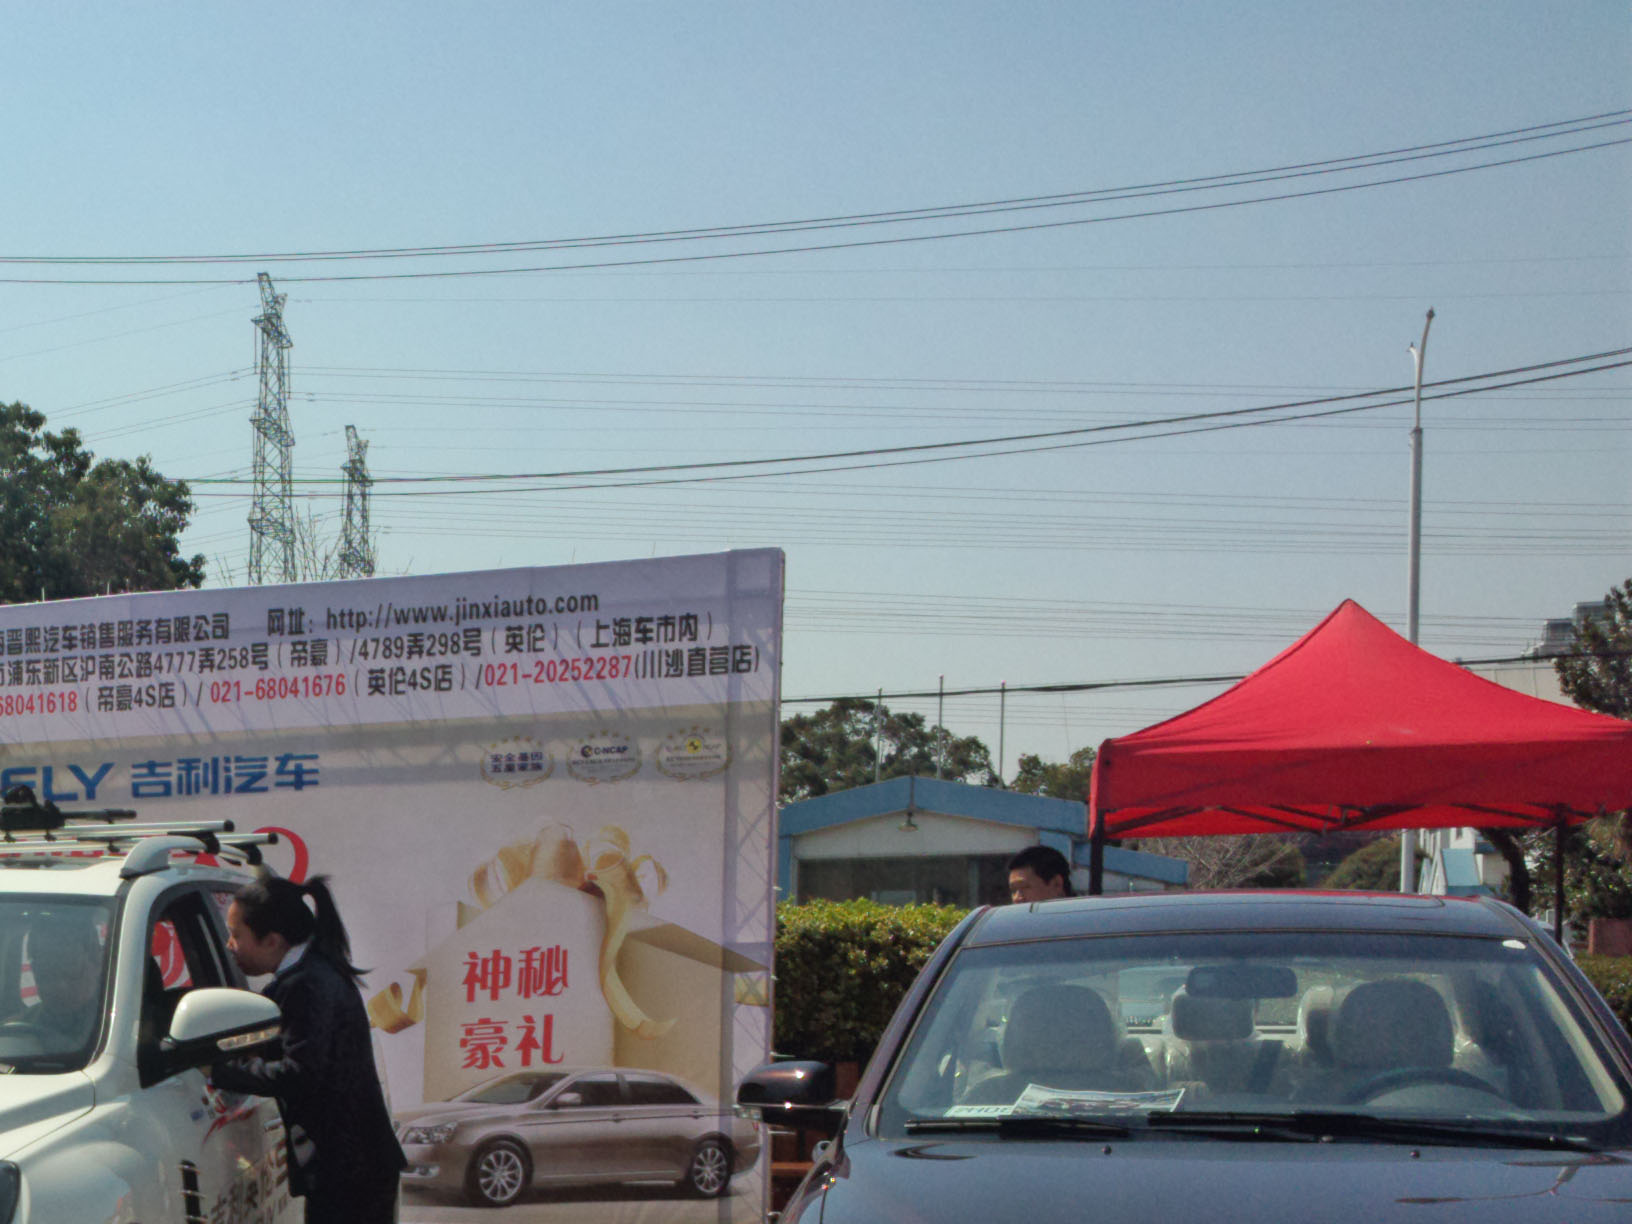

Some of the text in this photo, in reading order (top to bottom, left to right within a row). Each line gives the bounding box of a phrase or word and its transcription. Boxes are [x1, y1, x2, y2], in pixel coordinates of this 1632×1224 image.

[131, 753, 320, 799] 吉利汽车
[461, 945, 569, 1003] 神秘
[459, 1013, 565, 1070] 豪礼
